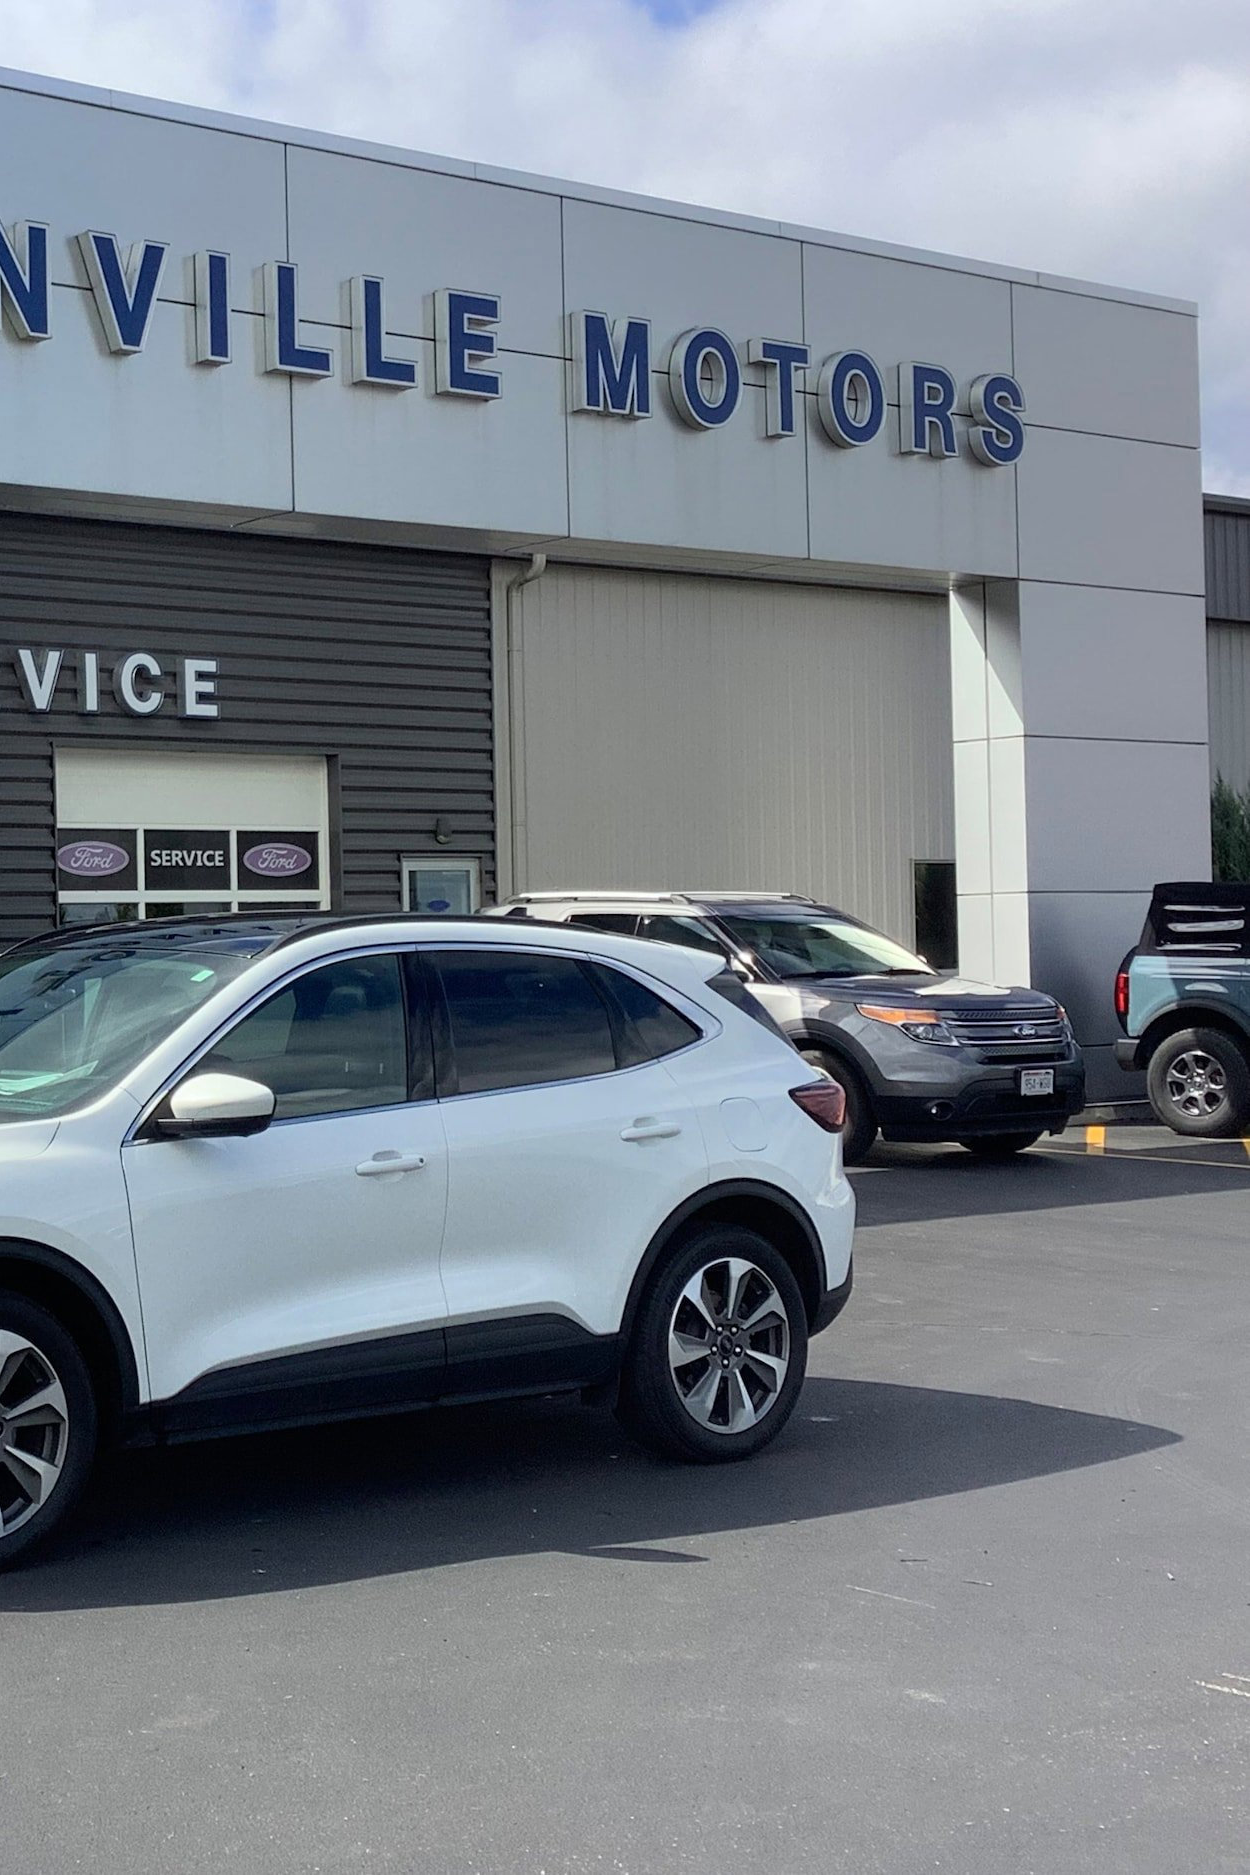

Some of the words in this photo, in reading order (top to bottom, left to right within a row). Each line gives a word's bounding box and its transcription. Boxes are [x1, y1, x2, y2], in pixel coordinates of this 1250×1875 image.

[570, 309, 1026, 467] MOTORS
[70, 846, 113, 869] Ford
[150, 850, 225, 867] SERVICE
[257, 848, 298, 870] Ford
